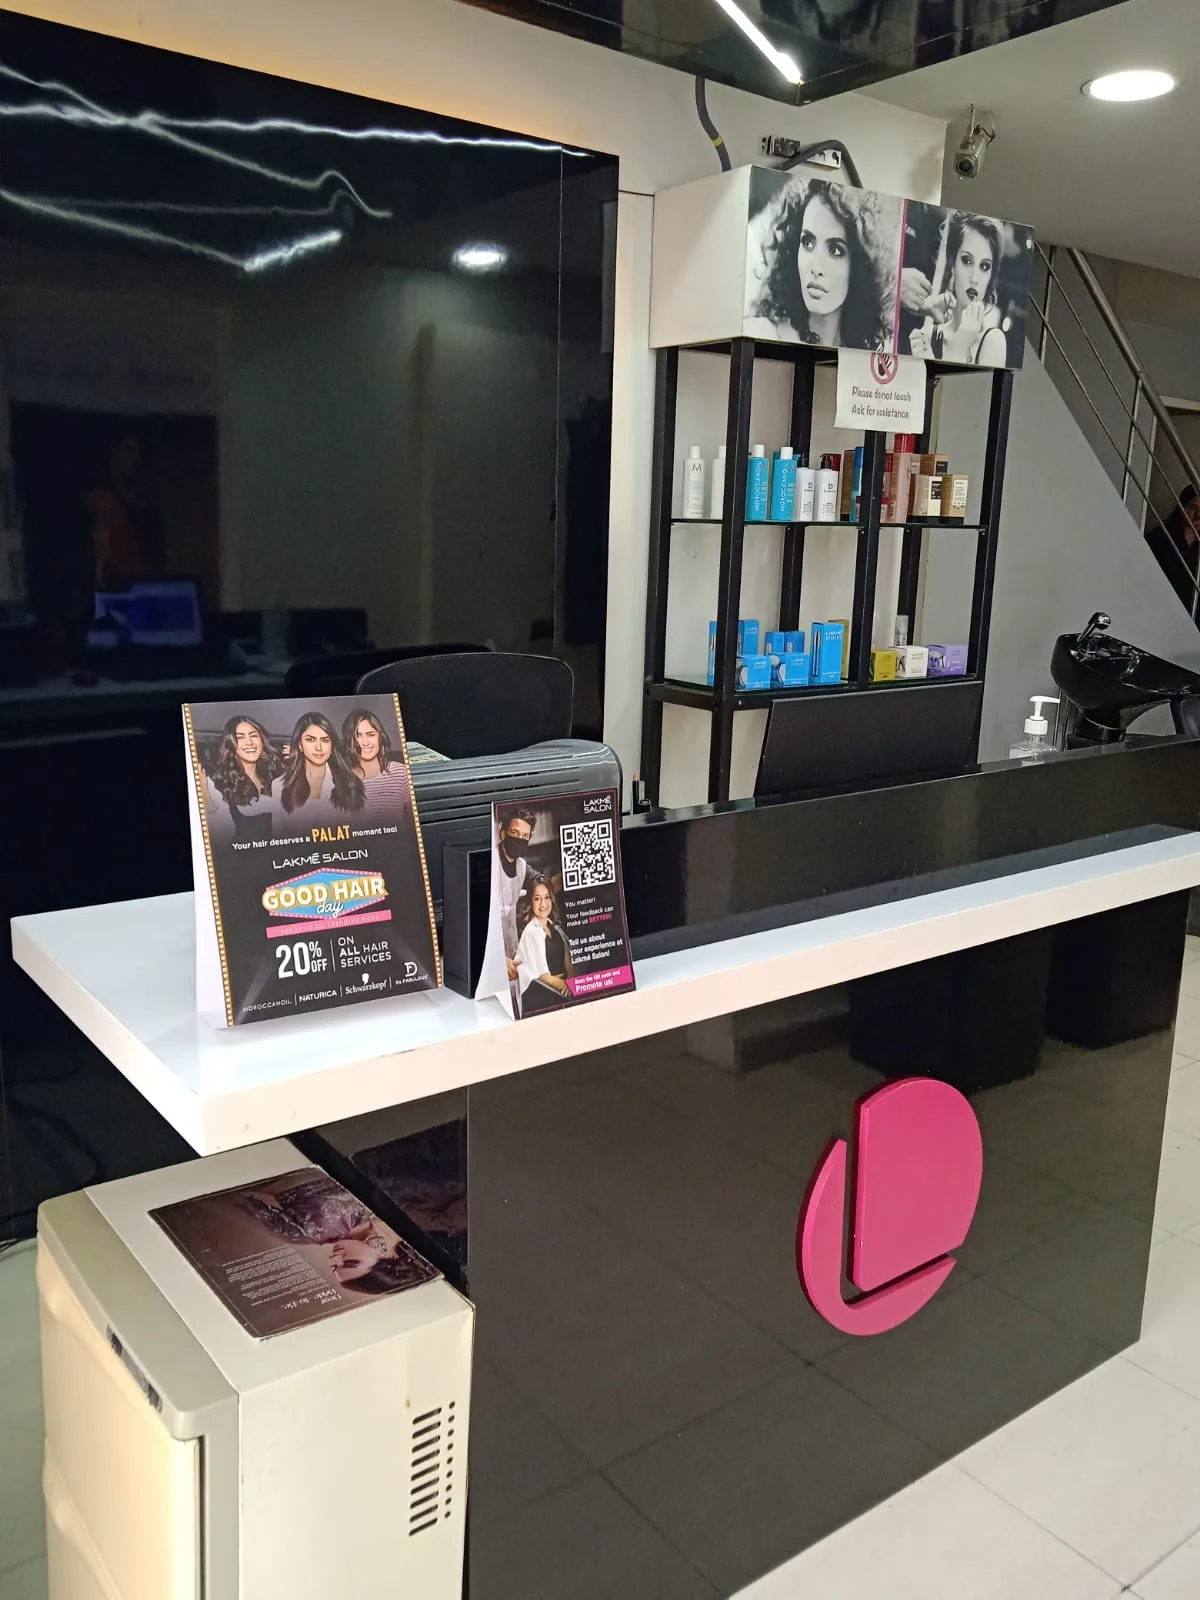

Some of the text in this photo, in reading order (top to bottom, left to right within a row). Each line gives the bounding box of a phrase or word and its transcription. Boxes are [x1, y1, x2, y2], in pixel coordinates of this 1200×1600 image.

[852, 386, 873, 398] Please
[893, 392, 912, 402] touch
[851, 404, 910, 419] Ask for assistance
[692, 463, 702, 472] M
[584, 795, 611, 807] LAKMÉ
[584, 804, 612, 814] SALON
[232, 842, 251, 851] Your
[252, 839, 268, 849] hair
[269, 837, 304, 847] deserves
[311, 825, 351, 843] PALAT
[352, 828, 383, 838] moment
[383, 825, 398, 834] too!
[272, 849, 369, 869] LAKMÉ SALON
[261, 876, 387, 912] GOOD HAIR
[577, 897, 596, 905] matter!
[316, 900, 344, 919] day
[566, 912, 579, 920] Your
[580, 907, 603, 917] feedback
[567, 920, 581, 928] make
[337, 935, 355, 947] ON
[568, 938, 579, 947] Tell
[589, 933, 605, 943] about
[570, 938, 623, 957] your experience at
[340, 941, 389, 958] ALL HAIR
[571, 949, 611, 965] Lakmé Salon!
[275, 940, 328, 979] 20% OFF
[340, 951, 392, 968] SERVICES
[574, 977, 586, 985] Scan
[575, 978, 614, 993] Promote us!
[242, 999, 292, 1012] MOROCCANOIL
[298, 989, 338, 1002] NATURICA
[344, 979, 388, 995] Schwarzkopf
